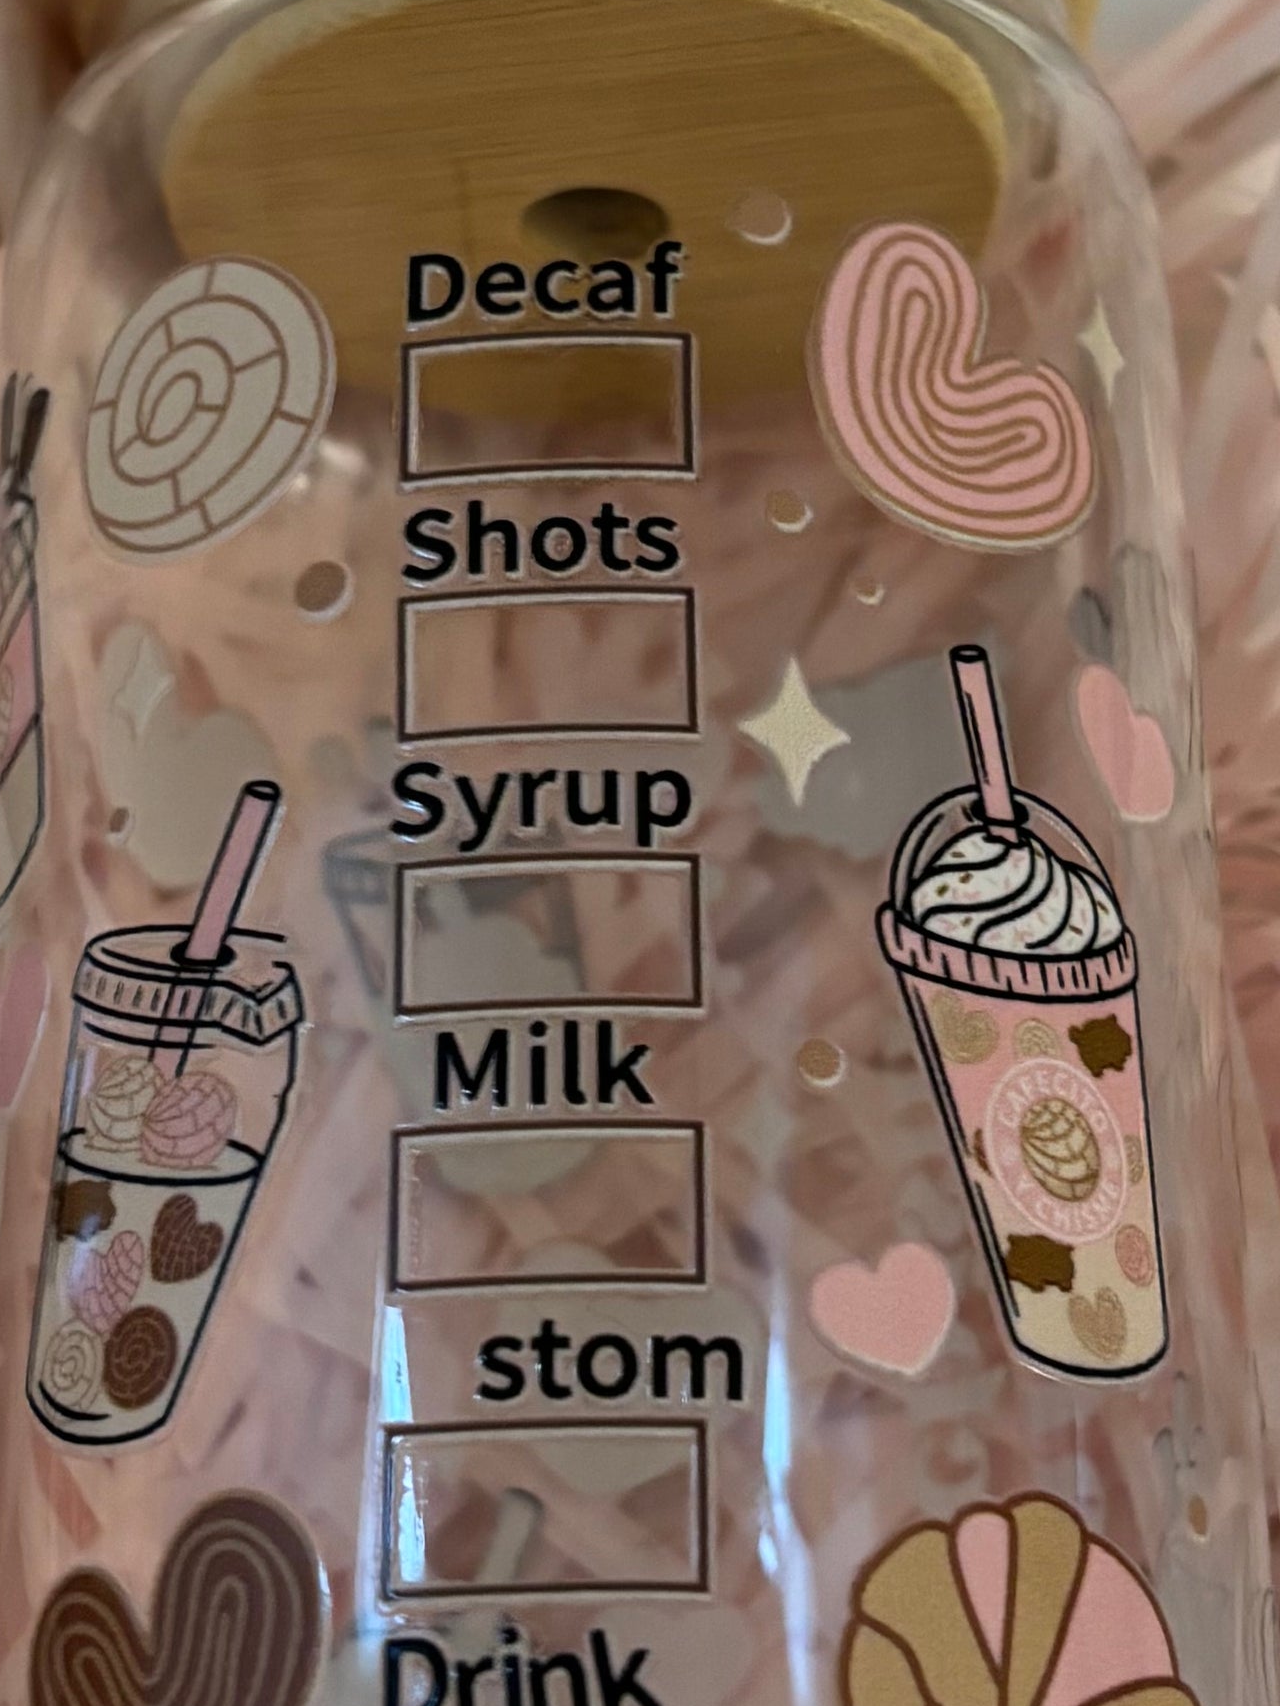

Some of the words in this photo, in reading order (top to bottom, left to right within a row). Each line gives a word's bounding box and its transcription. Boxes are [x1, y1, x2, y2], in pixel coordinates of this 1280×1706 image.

[407, 241, 683, 323] Decaf
[402, 500, 680, 582] Shots
[390, 761, 691, 852] Syrup
[434, 1020, 655, 1110] Milk
